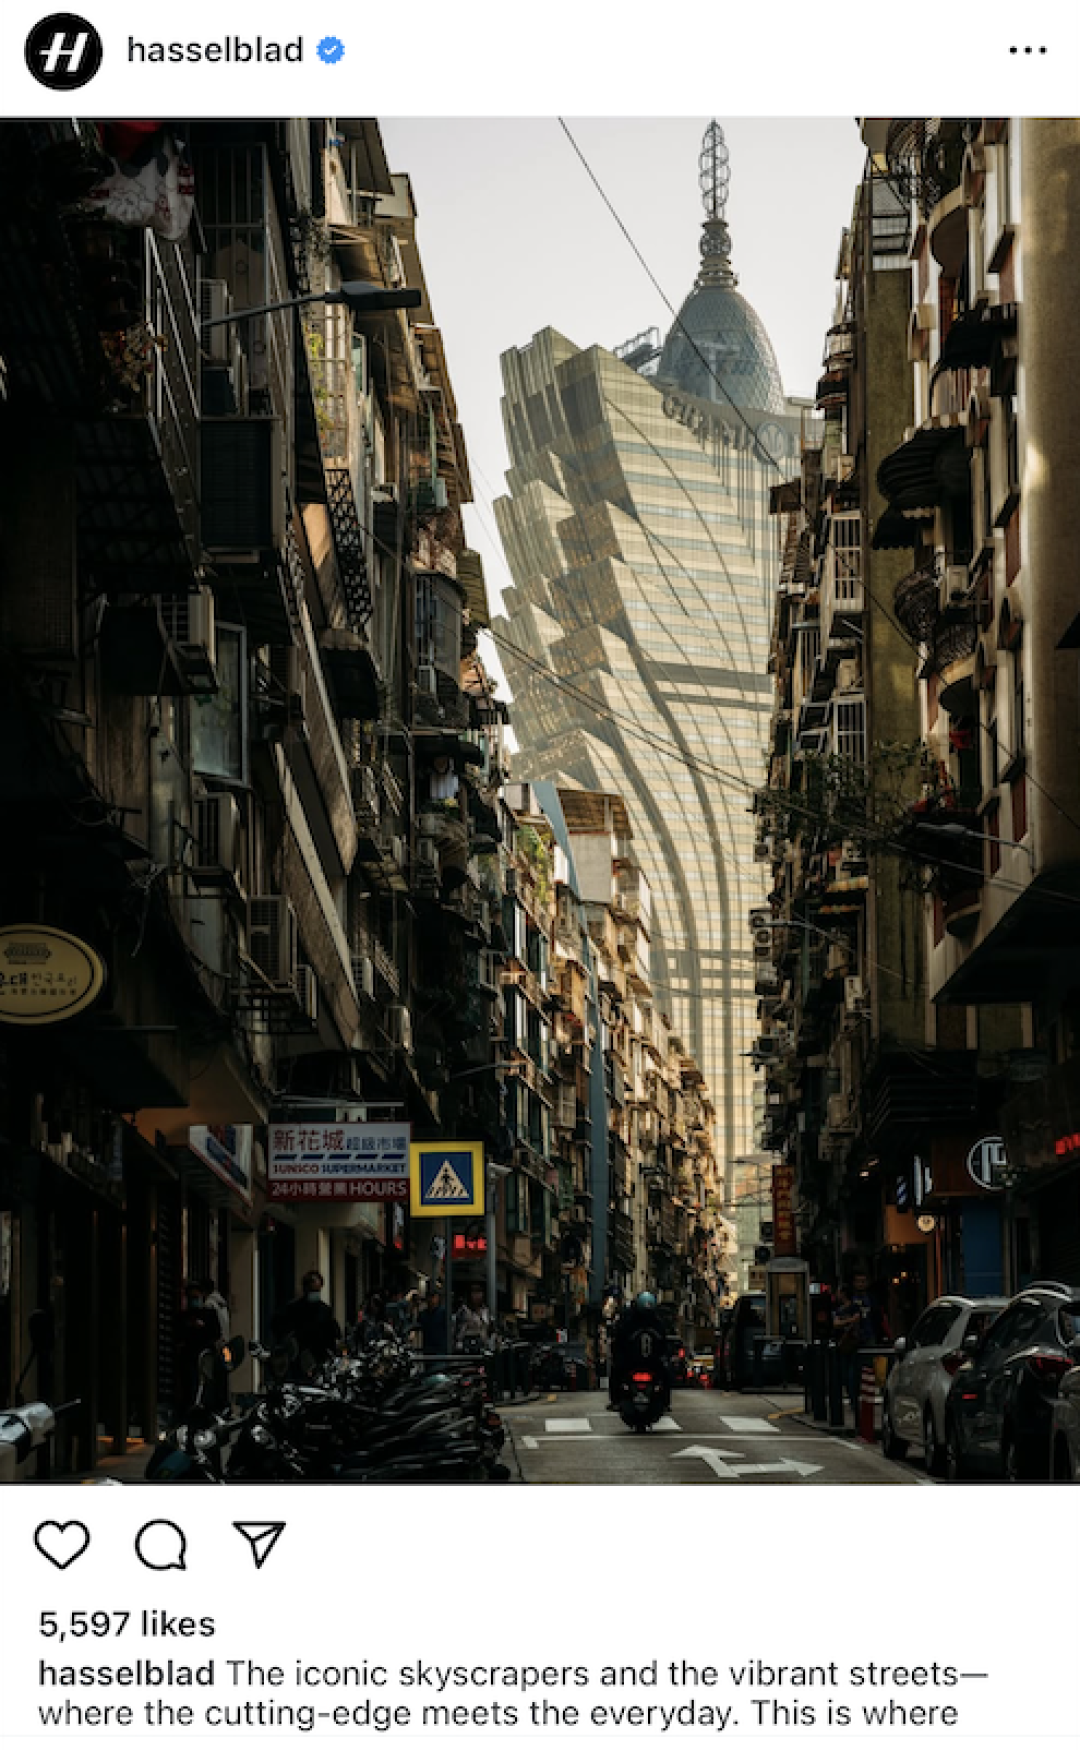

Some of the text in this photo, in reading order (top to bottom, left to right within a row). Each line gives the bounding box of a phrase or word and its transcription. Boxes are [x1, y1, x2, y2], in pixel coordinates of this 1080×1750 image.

[273, 1129, 345, 1151] 新花城
[321, 1163, 406, 1174] SUPERMARKET
[349, 1181, 407, 1197] HOURS
